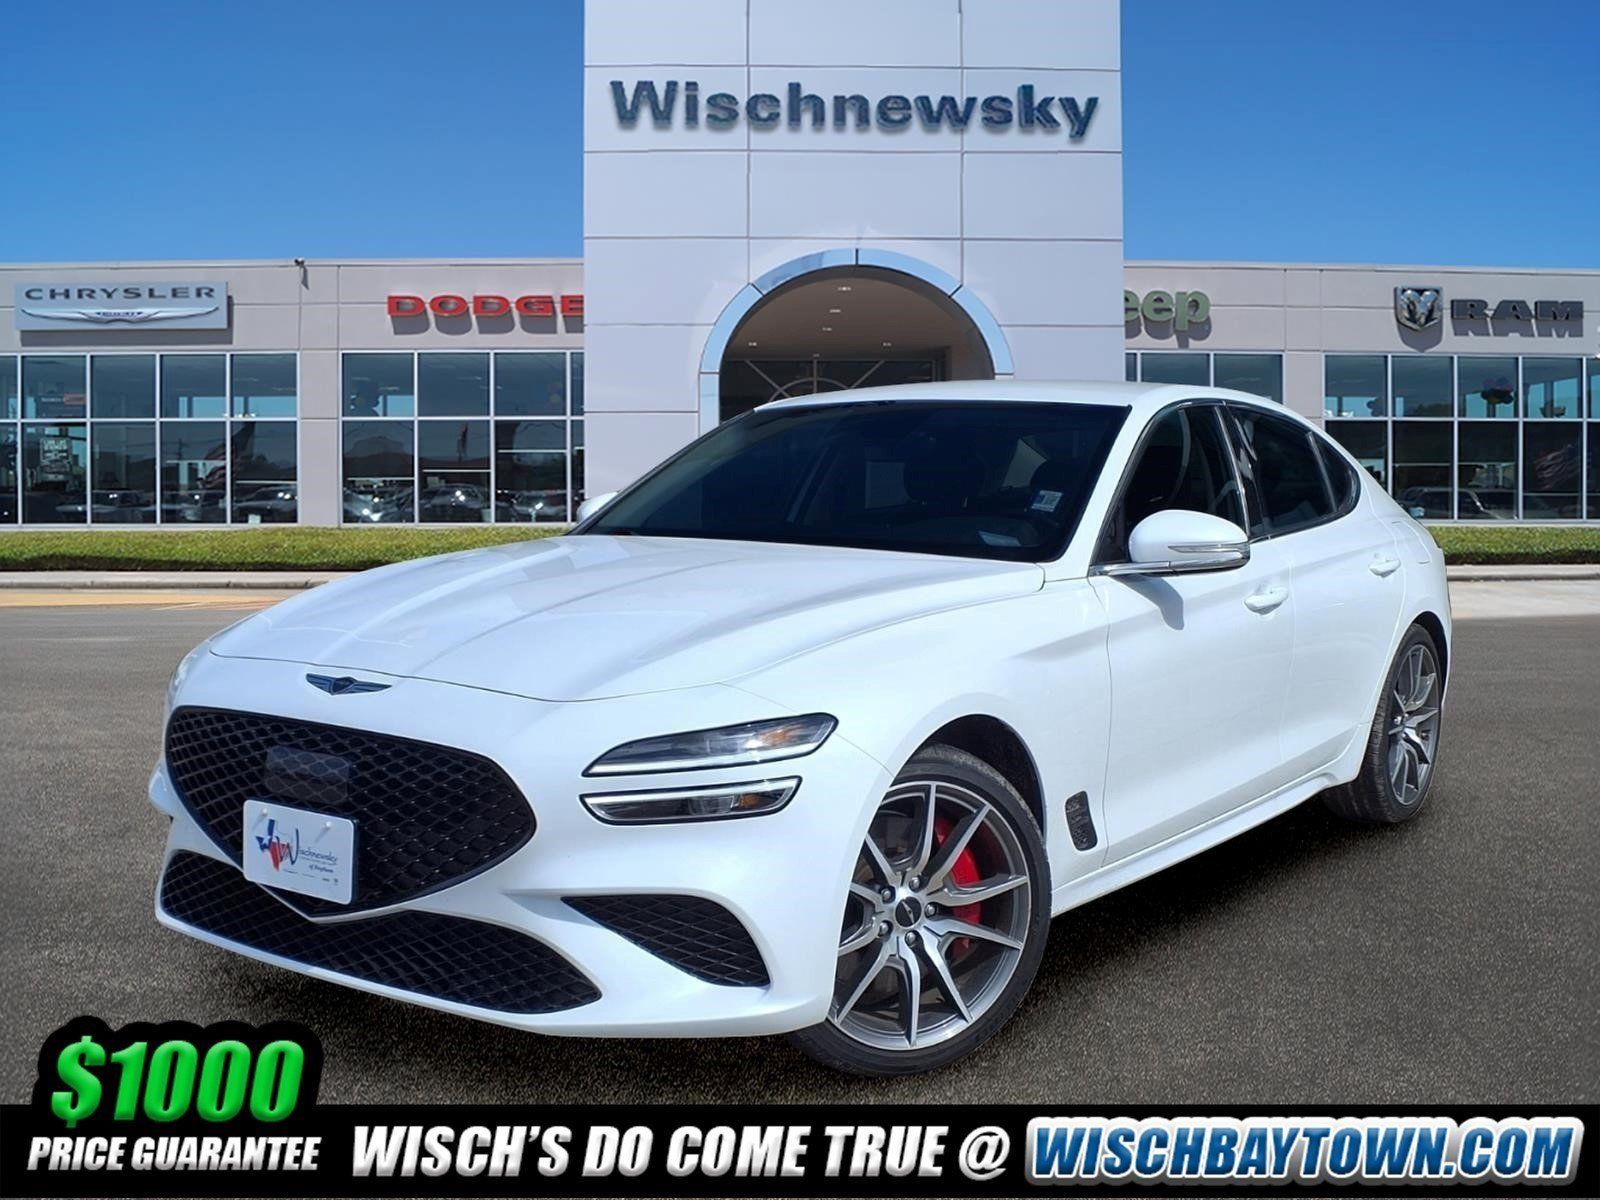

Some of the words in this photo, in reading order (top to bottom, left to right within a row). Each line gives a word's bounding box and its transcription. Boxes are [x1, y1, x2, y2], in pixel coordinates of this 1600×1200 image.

[609, 79, 1099, 139] Wischnewsky
[24, 286, 216, 301] CHRYSLER
[387, 295, 585, 317] DODGE
[1123, 289, 1211, 332] eep
[1450, 299, 1584, 321] RAM
